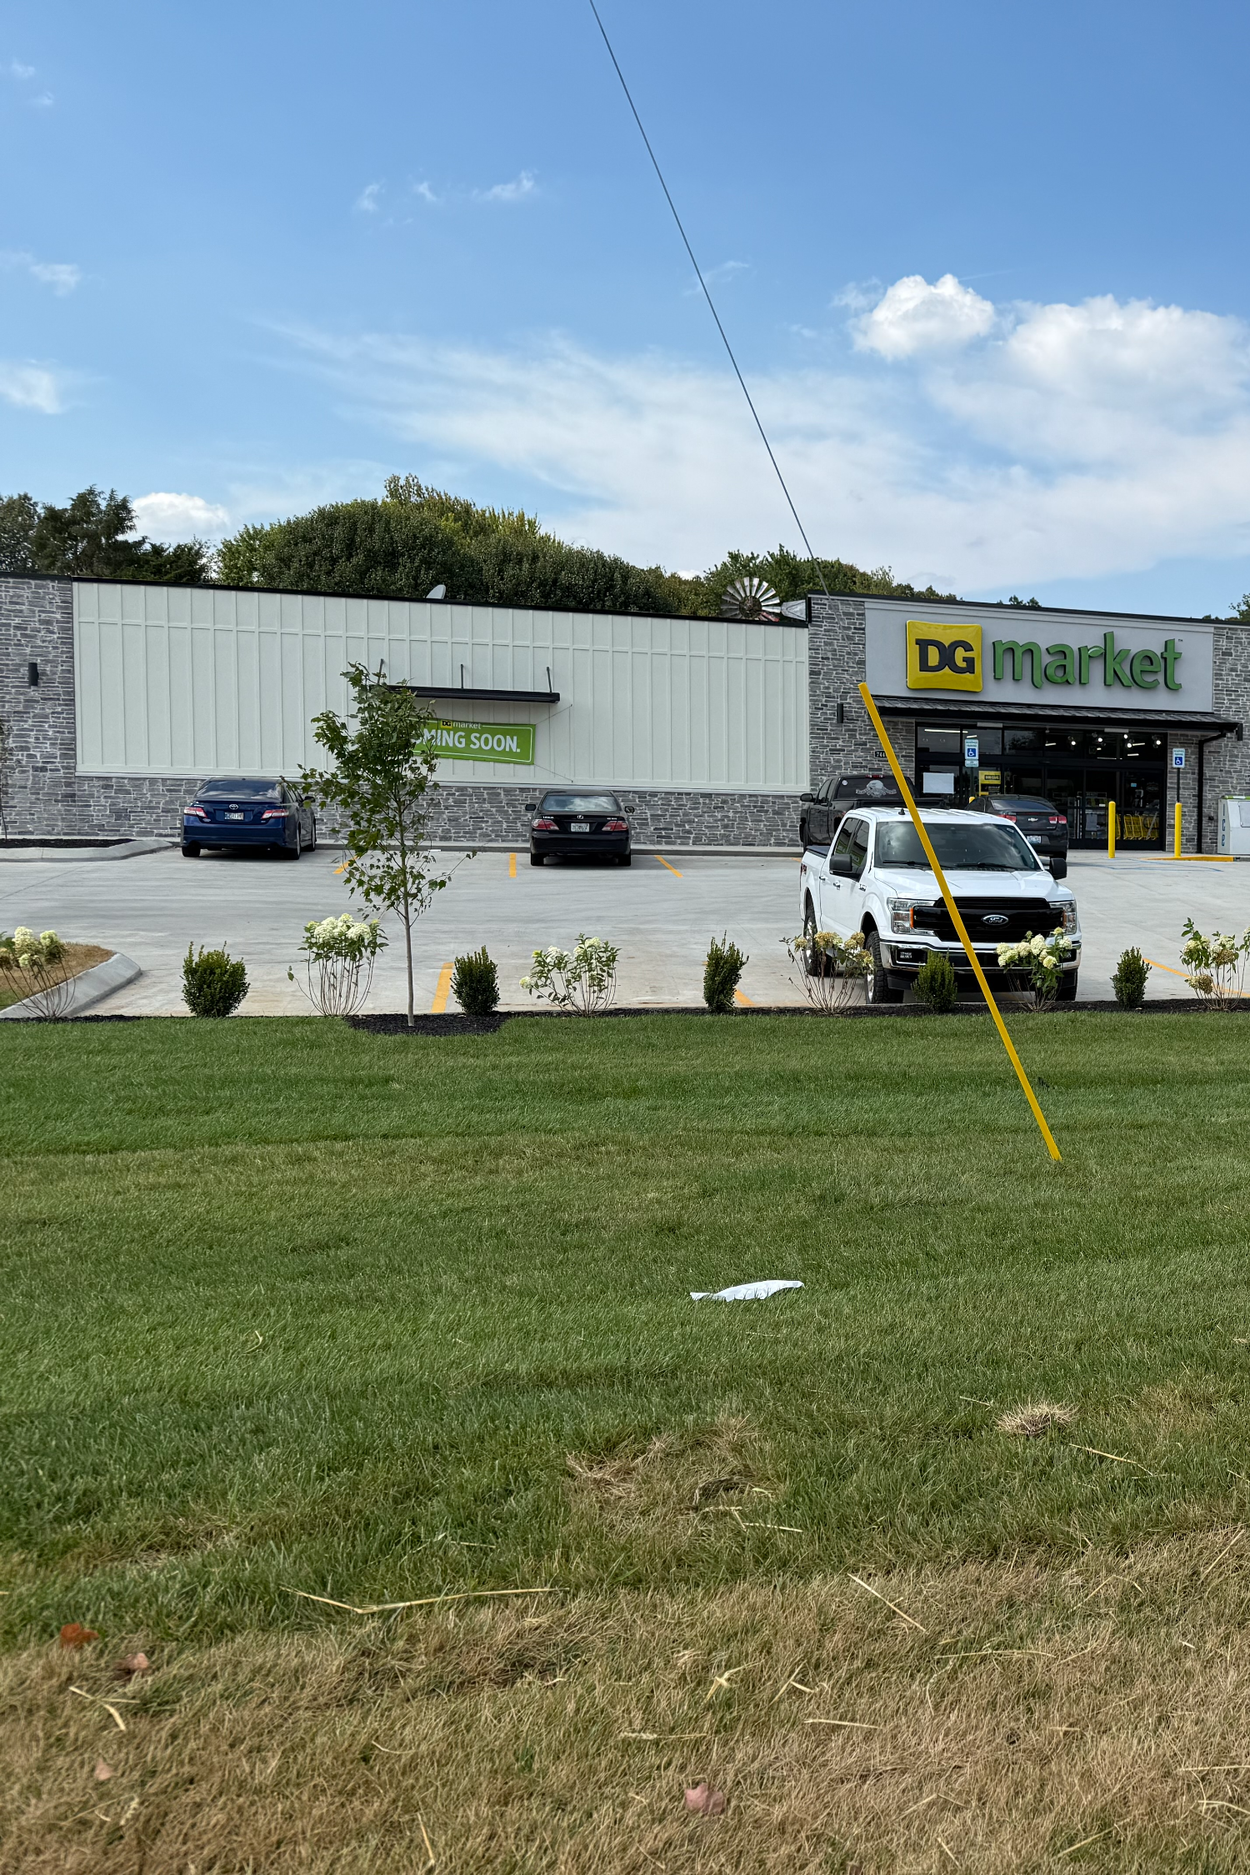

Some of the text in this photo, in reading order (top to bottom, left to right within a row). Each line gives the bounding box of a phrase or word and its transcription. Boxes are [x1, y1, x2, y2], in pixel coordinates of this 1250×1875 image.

[915, 631, 1182, 690] DG market
[453, 721, 481, 729] market
[410, 728, 520, 753] MING SOON.
